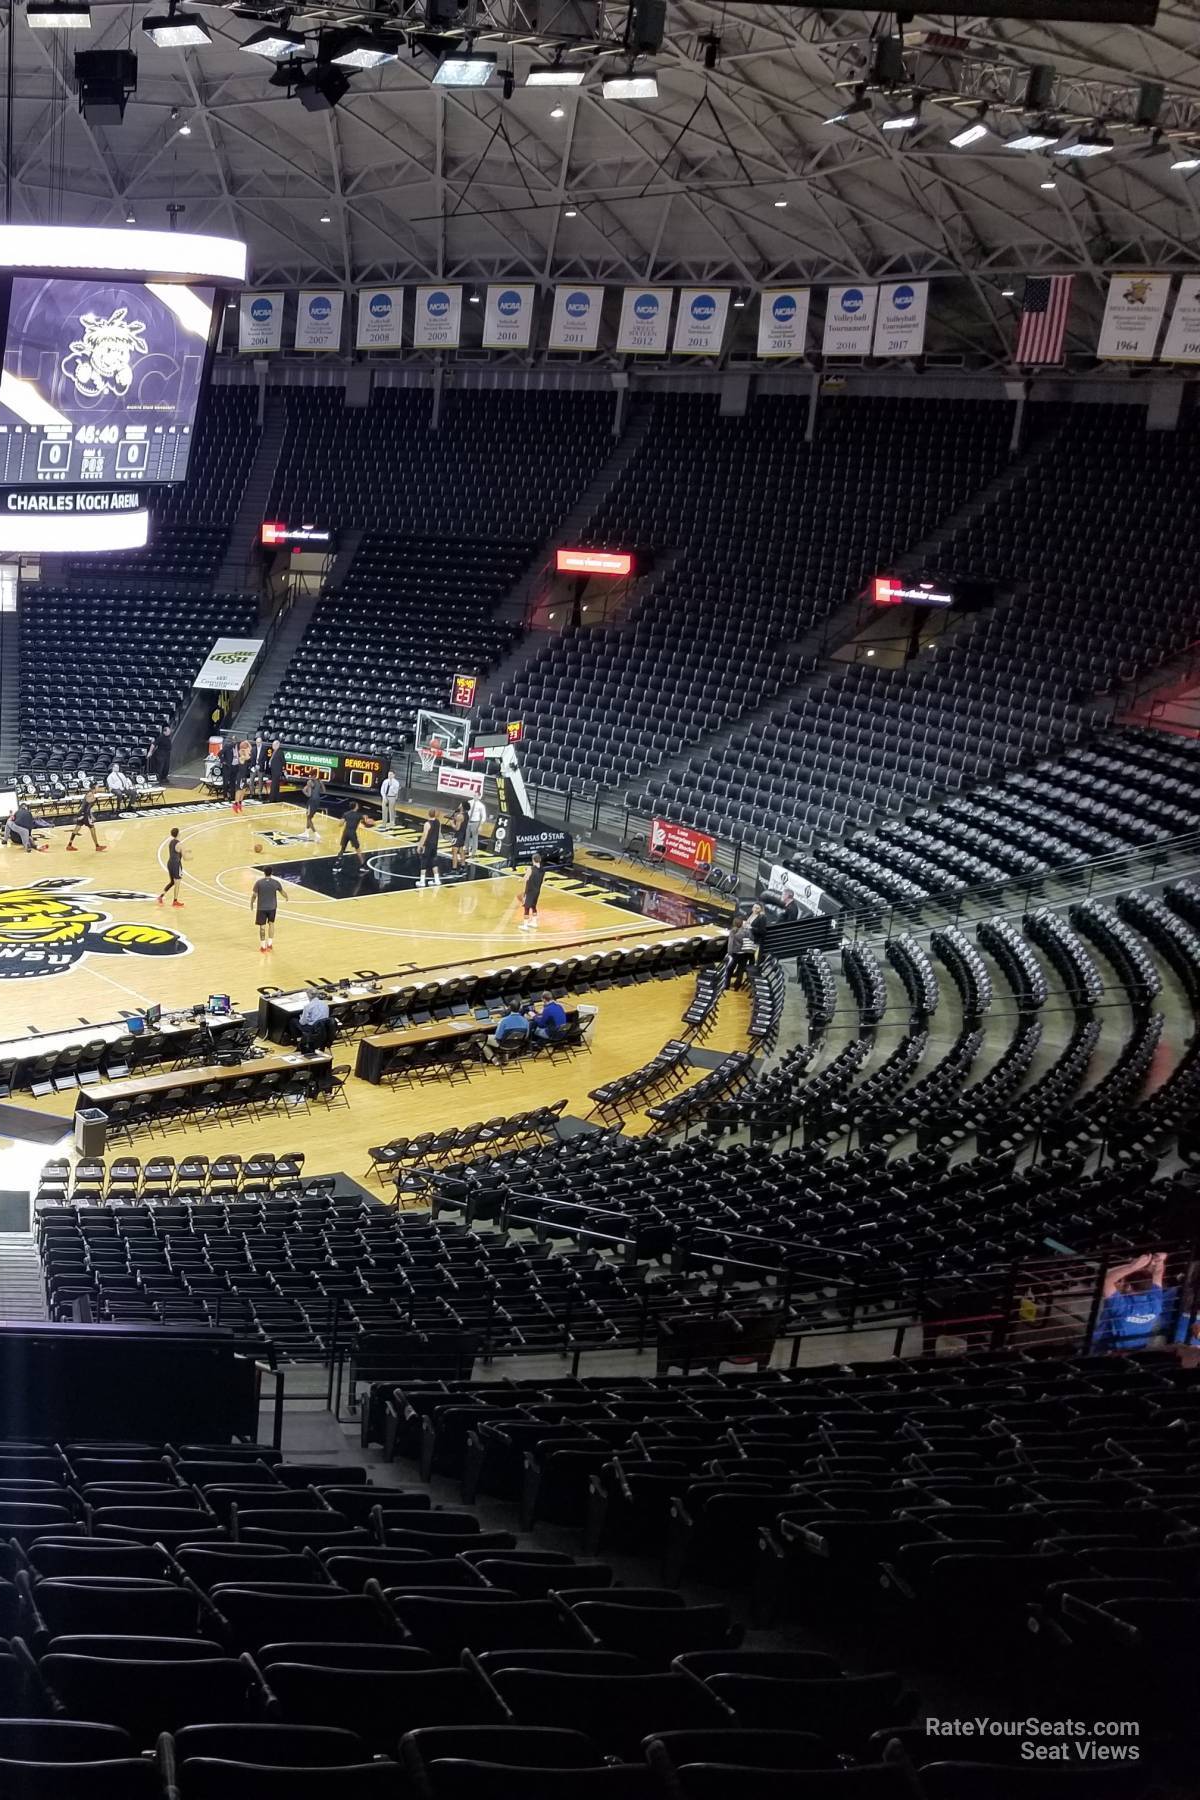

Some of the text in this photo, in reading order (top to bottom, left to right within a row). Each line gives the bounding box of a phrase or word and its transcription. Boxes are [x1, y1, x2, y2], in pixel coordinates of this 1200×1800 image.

[251, 337, 268, 345] 2004
[563, 334, 584, 342] 2011
[631, 337, 653, 345] 2012
[688, 338, 708, 347] 2013
[888, 341, 908, 350] 2017
[1116, 340, 1138, 350] 1964
[49, 444, 61, 464] 0
[127, 444, 139, 463] 0
[8, 493, 139, 510] CHARLES KOCH ARENA
[456, 688, 470, 703] 23
[345, 758, 380, 770] BEARCATS
[440, 773, 482, 796] ESPN
[496, 778, 507, 812] WSU
